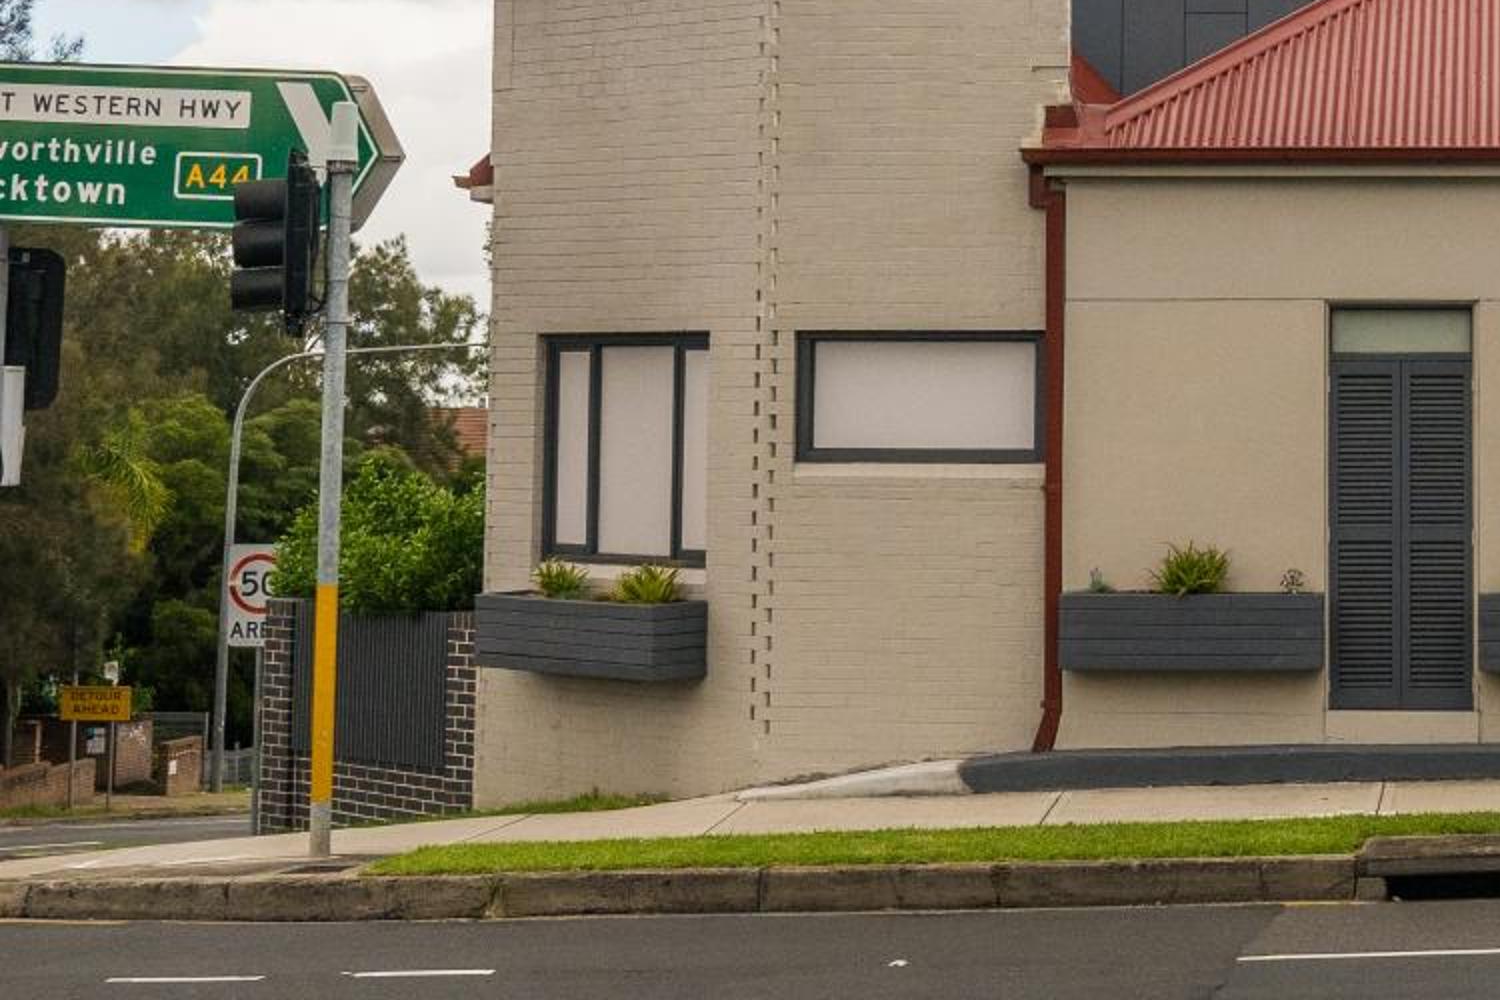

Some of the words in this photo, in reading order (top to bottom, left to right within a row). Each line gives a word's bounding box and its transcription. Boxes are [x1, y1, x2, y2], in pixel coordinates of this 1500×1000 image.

[33, 93, 161, 117] WESTERN
[179, 98, 241, 119] HWY
[185, 163, 250, 189] A44
